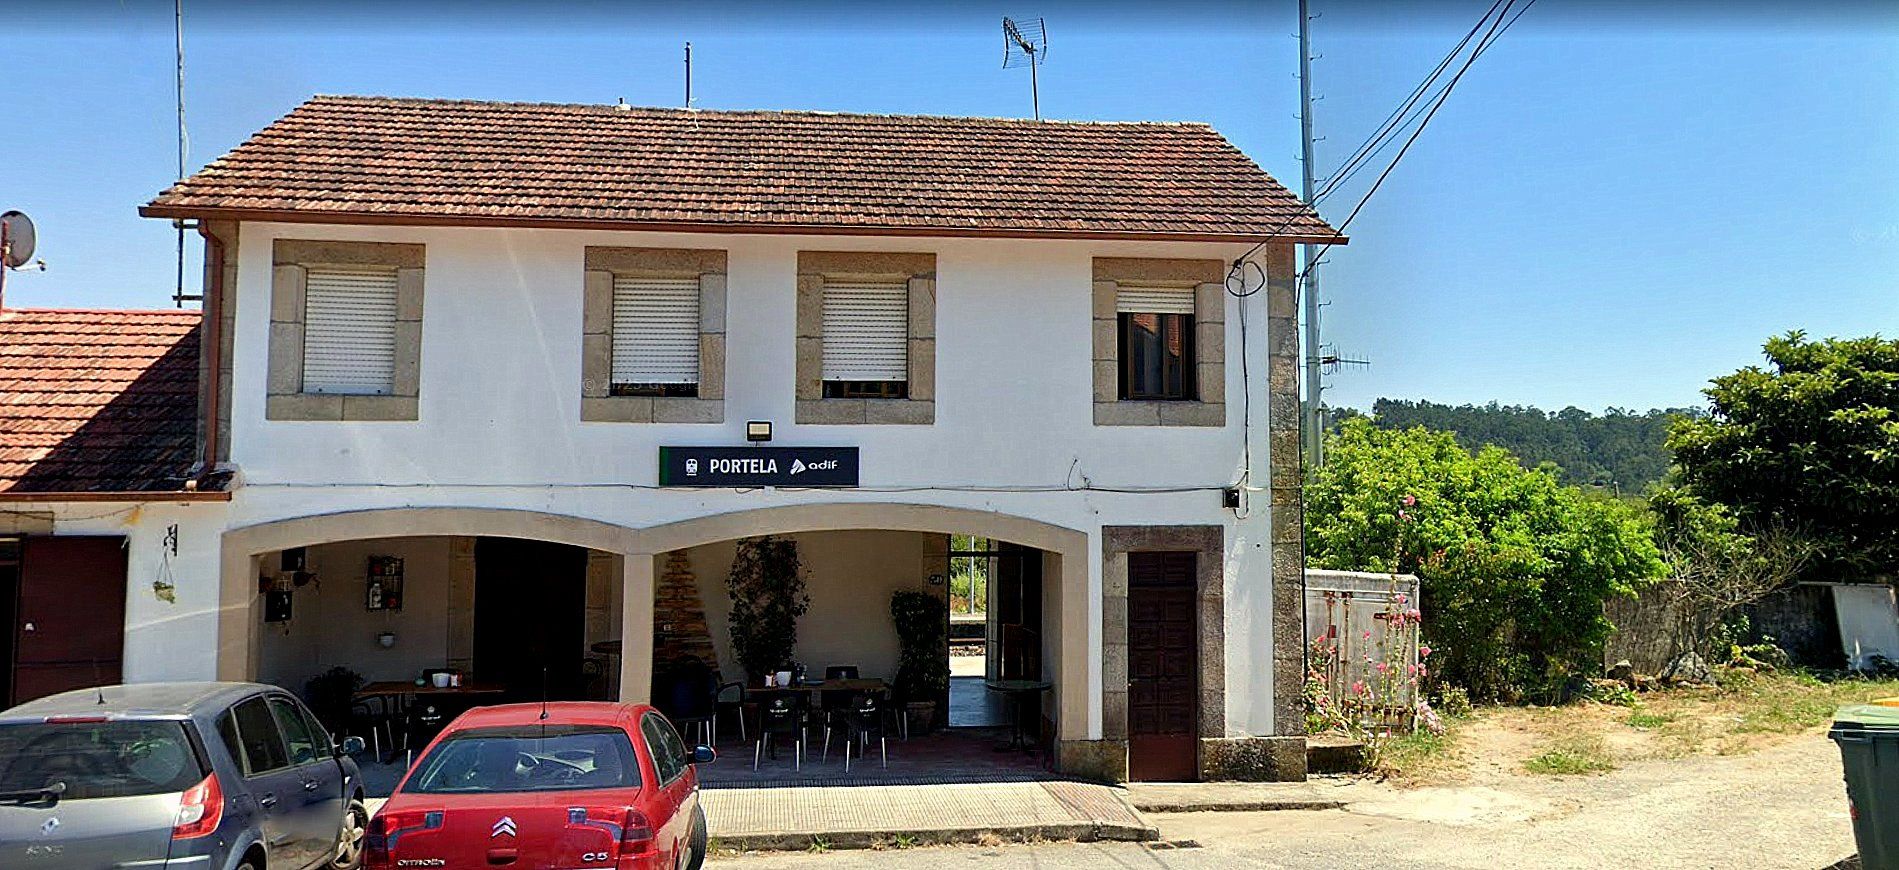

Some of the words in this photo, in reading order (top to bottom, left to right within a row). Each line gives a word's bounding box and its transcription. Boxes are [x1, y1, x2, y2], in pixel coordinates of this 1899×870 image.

[709, 458, 778, 474] PORTELA
[807, 459, 839, 470] adif
[582, 851, 609, 861] C5
